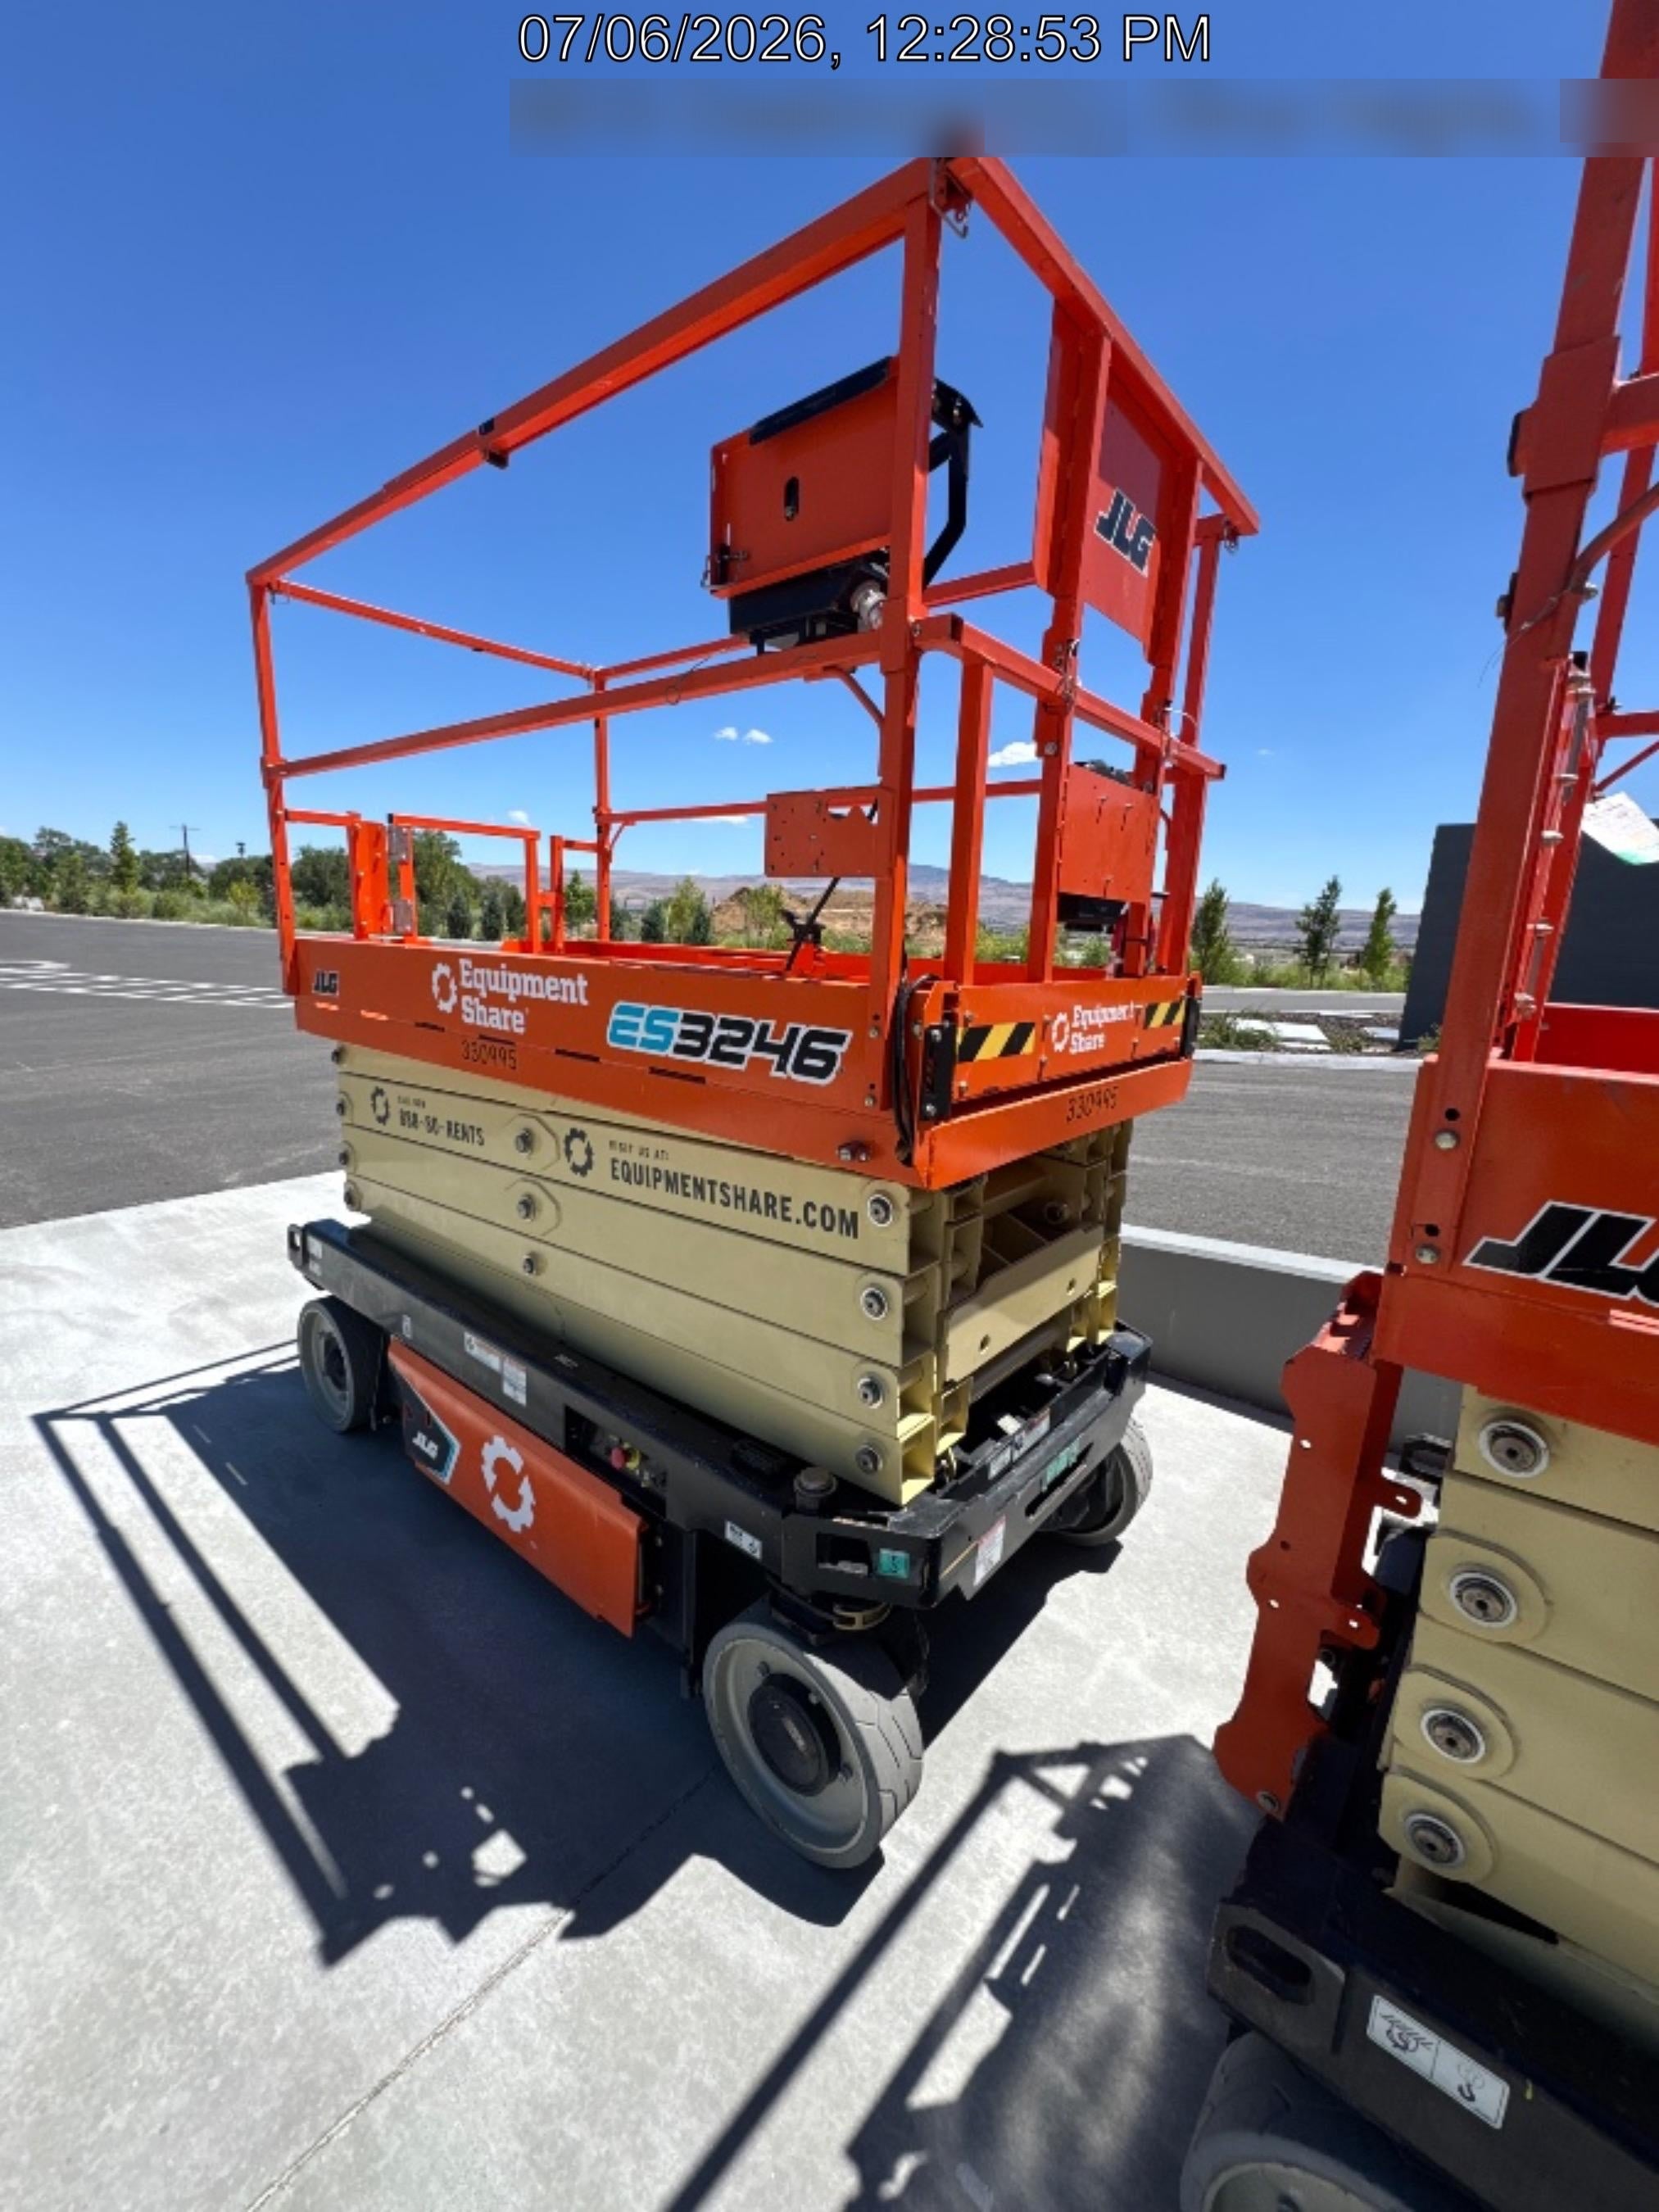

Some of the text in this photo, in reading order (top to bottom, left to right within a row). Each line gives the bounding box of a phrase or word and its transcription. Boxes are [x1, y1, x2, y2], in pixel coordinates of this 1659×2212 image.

[1095, 487, 1158, 577] JLG
[312, 970, 339, 997] JLG
[459, 958, 589, 1007] Equipment
[460, 995, 525, 1035] Share
[606, 999, 854, 1086] ES3246
[610, 1157, 859, 1240] EQUIPMENTSHARE.COM
[1462, 1199, 1659, 1308] JL
[412, 1430, 438, 1460] JLG
